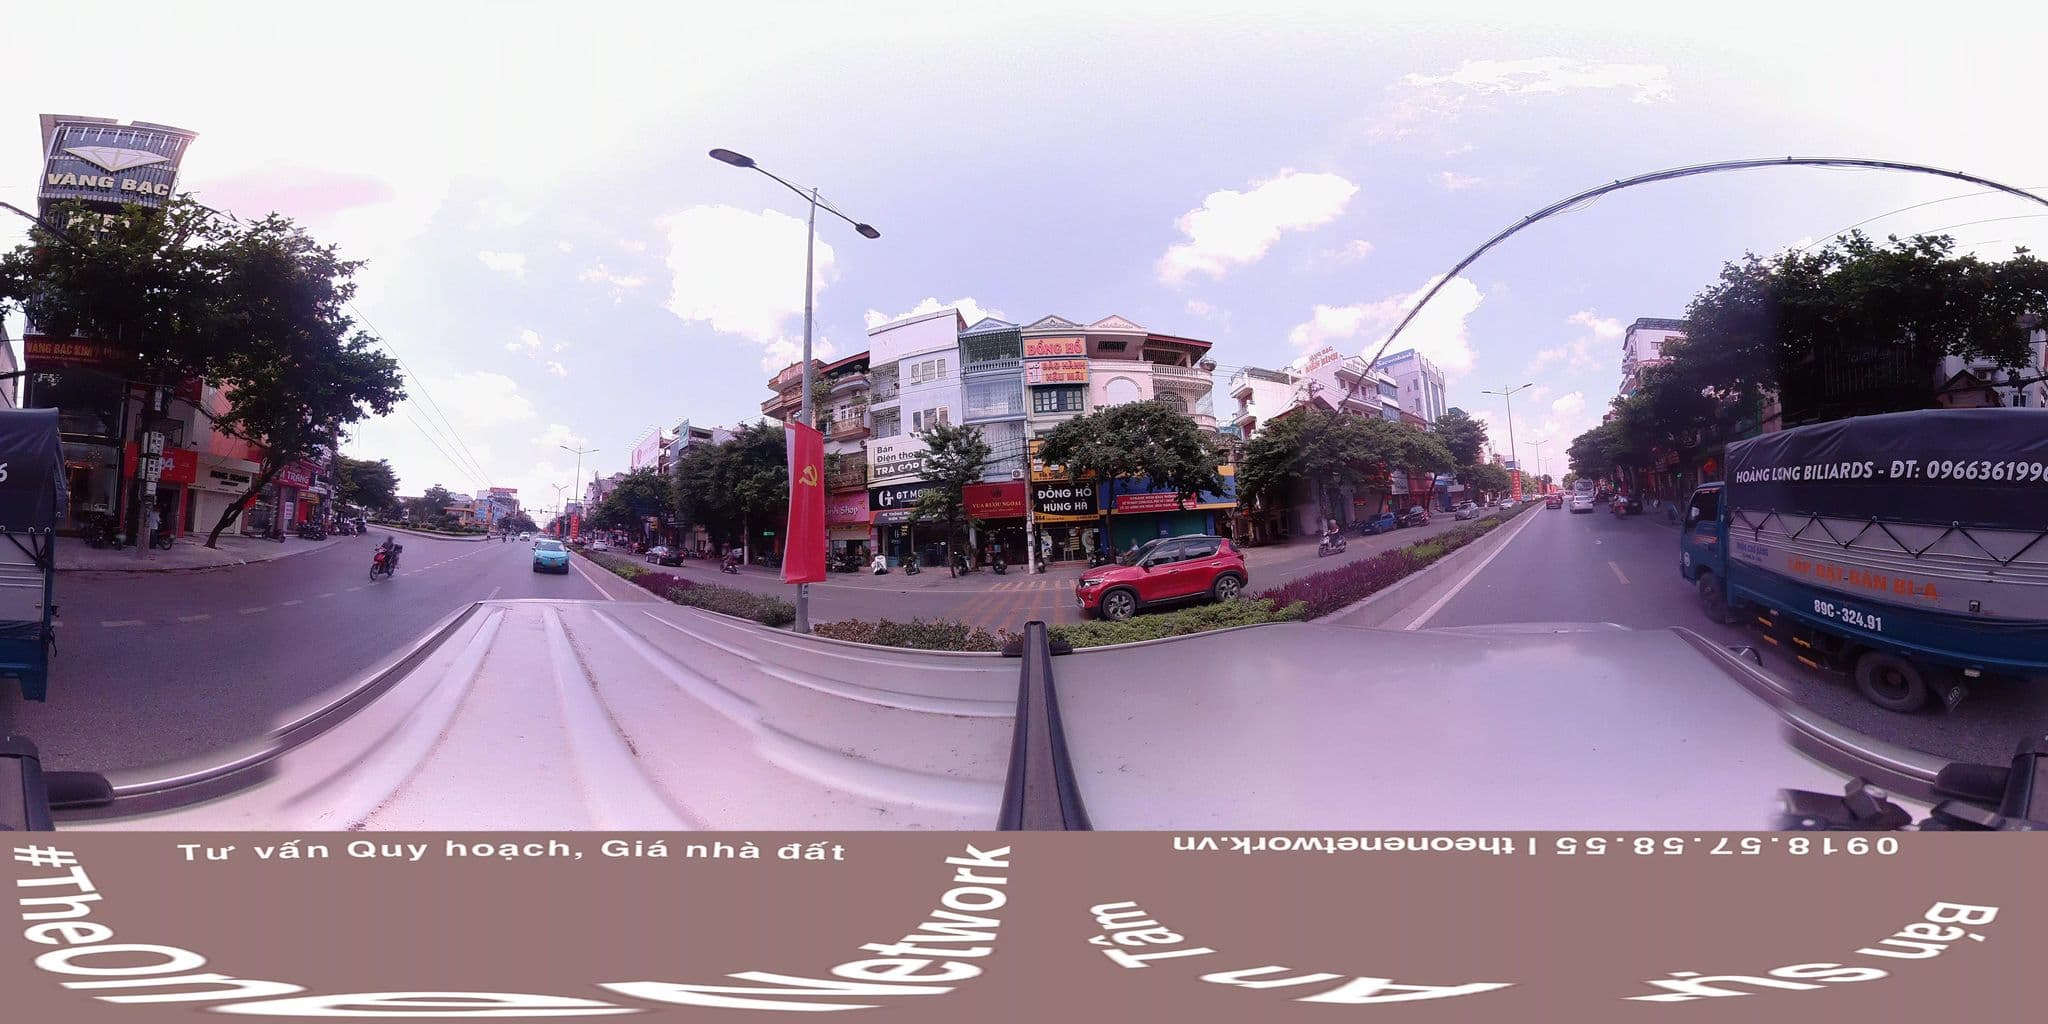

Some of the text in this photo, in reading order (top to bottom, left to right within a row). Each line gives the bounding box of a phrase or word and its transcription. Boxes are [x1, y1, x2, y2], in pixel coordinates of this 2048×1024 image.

[48, 172, 170, 196] VÀNG BẠC
[1027, 338, 1082, 356] ĐỒNG HỒ
[877, 446, 893, 454] Bán
[876, 464, 895, 476] TRẢ
[898, 461, 920, 473] GÓP
[1736, 466, 1770, 483] HOÀNG
[1803, 461, 1874, 481] BILIARDS
[1890, 459, 1920, 479] ĐT:
[896, 490, 909, 499] GT
[1038, 483, 1092, 499] ĐỒNG HỒ
[840, 504, 858, 516] Shop
[1043, 499, 1088, 512] HÙNG HÀ
[1814, 599, 1882, 632] 89C-324.91
